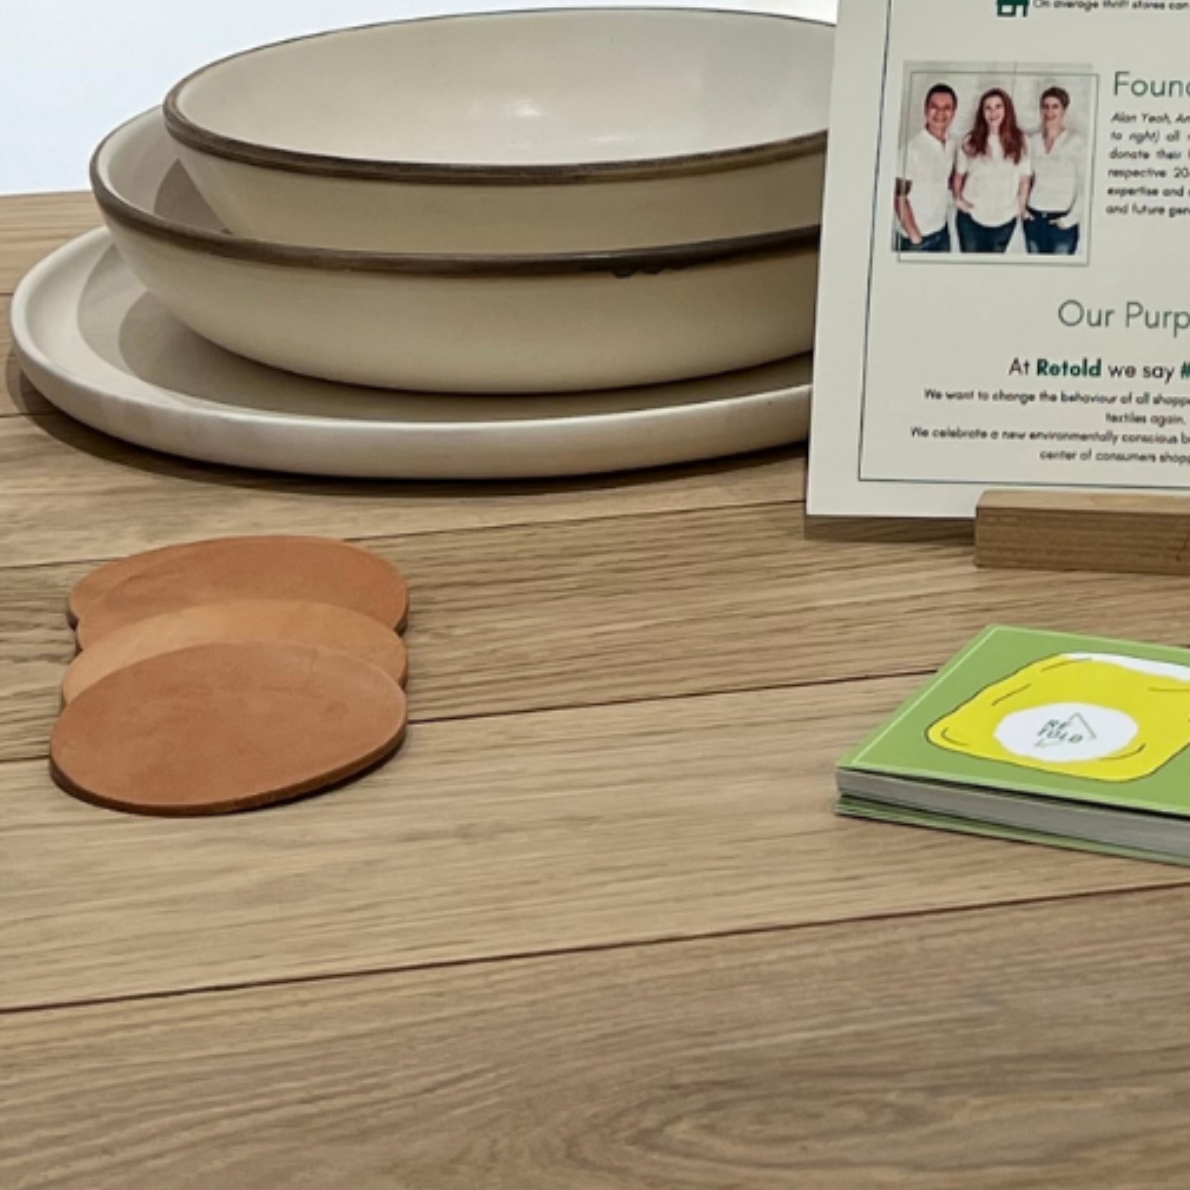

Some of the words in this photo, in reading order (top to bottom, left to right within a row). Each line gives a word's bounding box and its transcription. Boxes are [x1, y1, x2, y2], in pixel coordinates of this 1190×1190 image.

[1053, 0, 1099, 12] average
[1132, 0, 1165, 9] stores
[1169, 2, 1189, 11] can
[1058, 299, 1114, 327] Our
[1010, 357, 1029, 375] At
[1037, 357, 1101, 377] Retold
[1109, 365, 1136, 378] we
[1143, 365, 1174, 384] say
